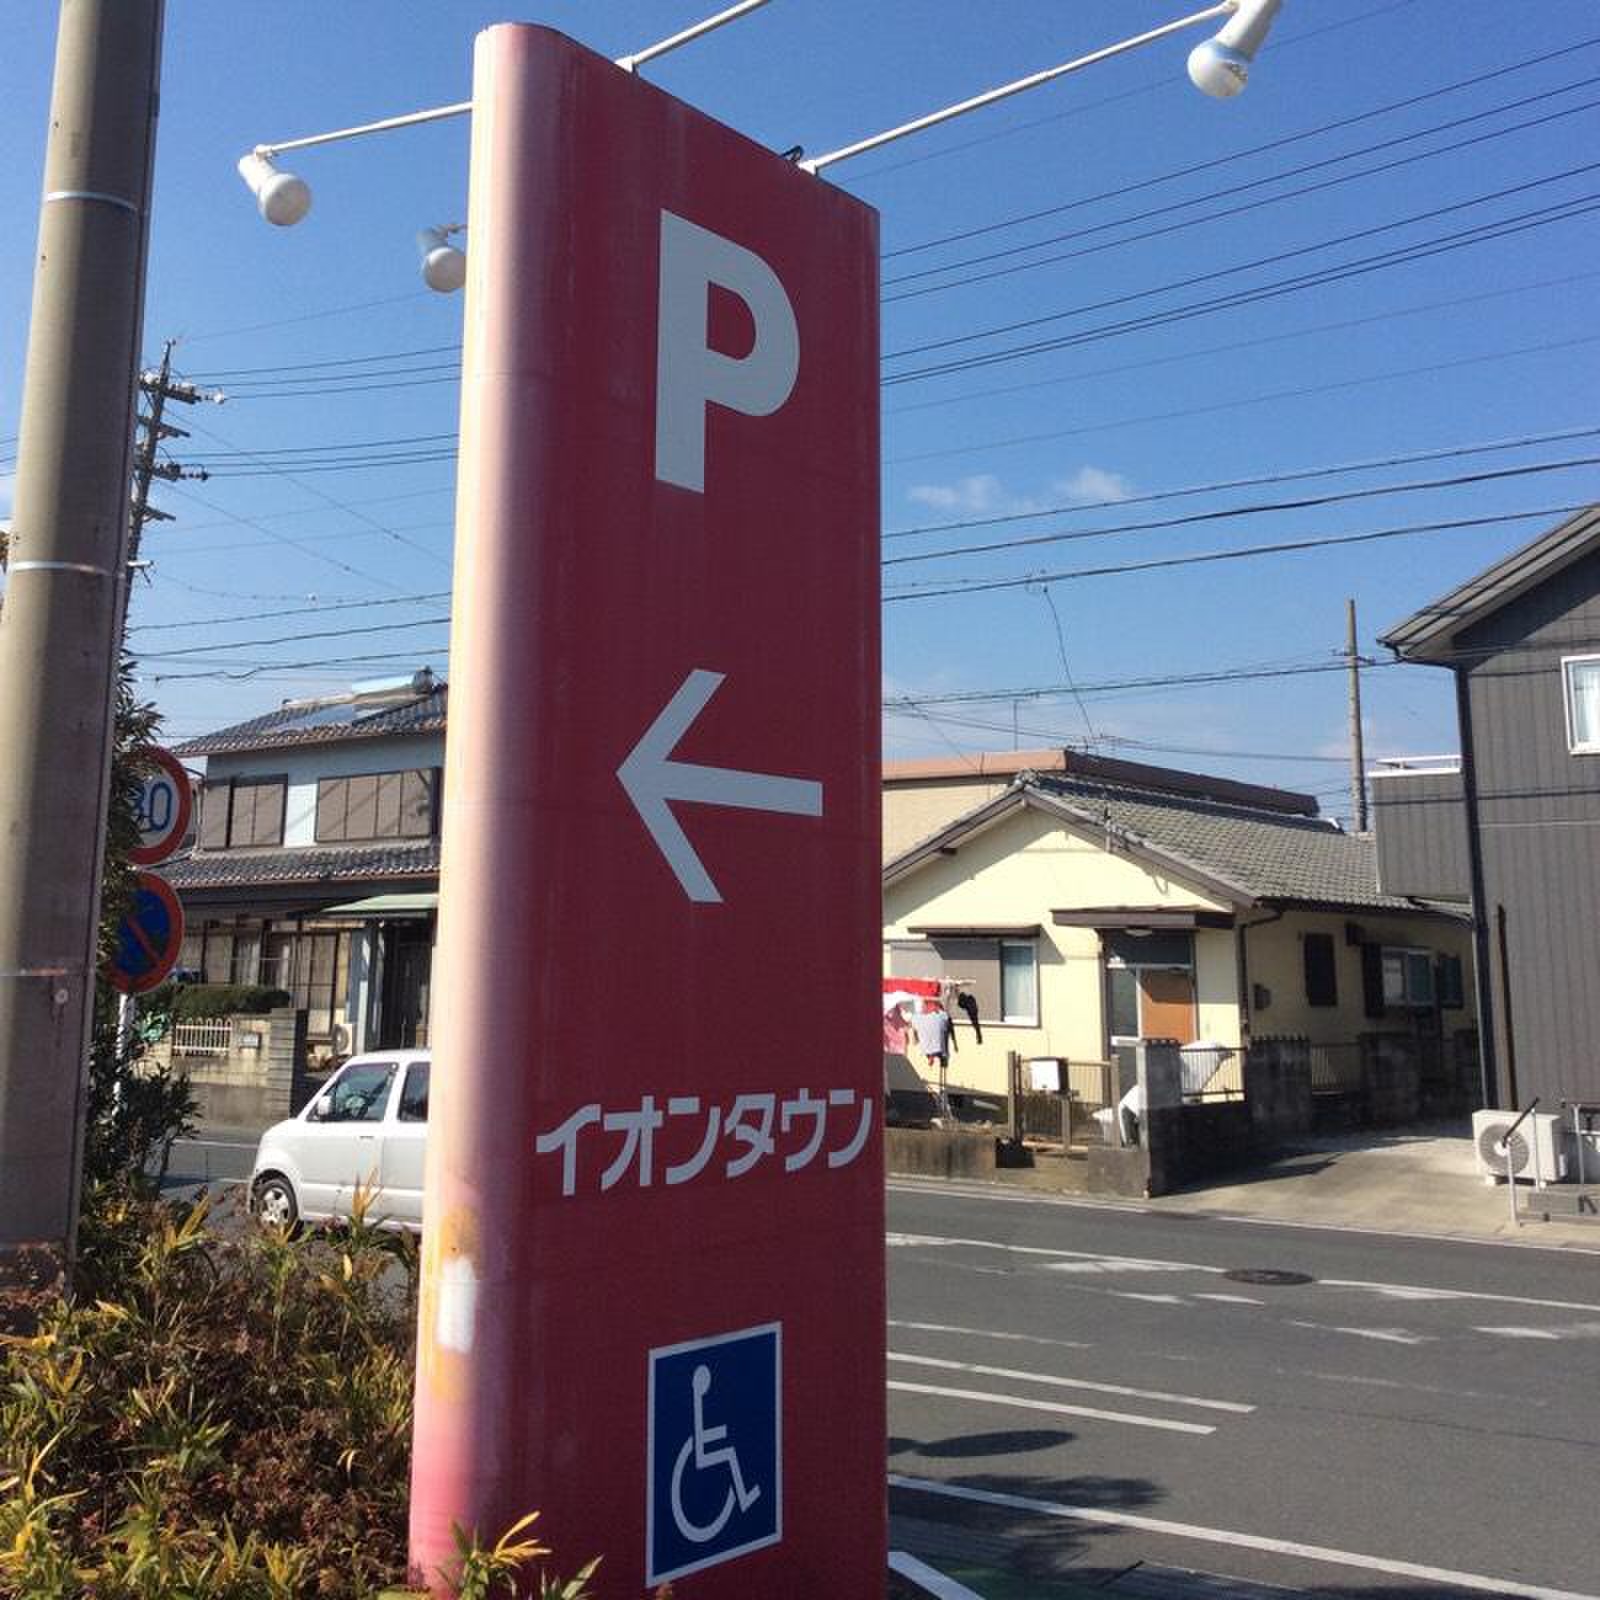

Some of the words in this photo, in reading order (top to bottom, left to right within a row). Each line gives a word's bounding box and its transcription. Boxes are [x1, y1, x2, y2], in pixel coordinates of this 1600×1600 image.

[655, 208, 800, 494] P
[536, 1088, 872, 1196] イオンタウン
